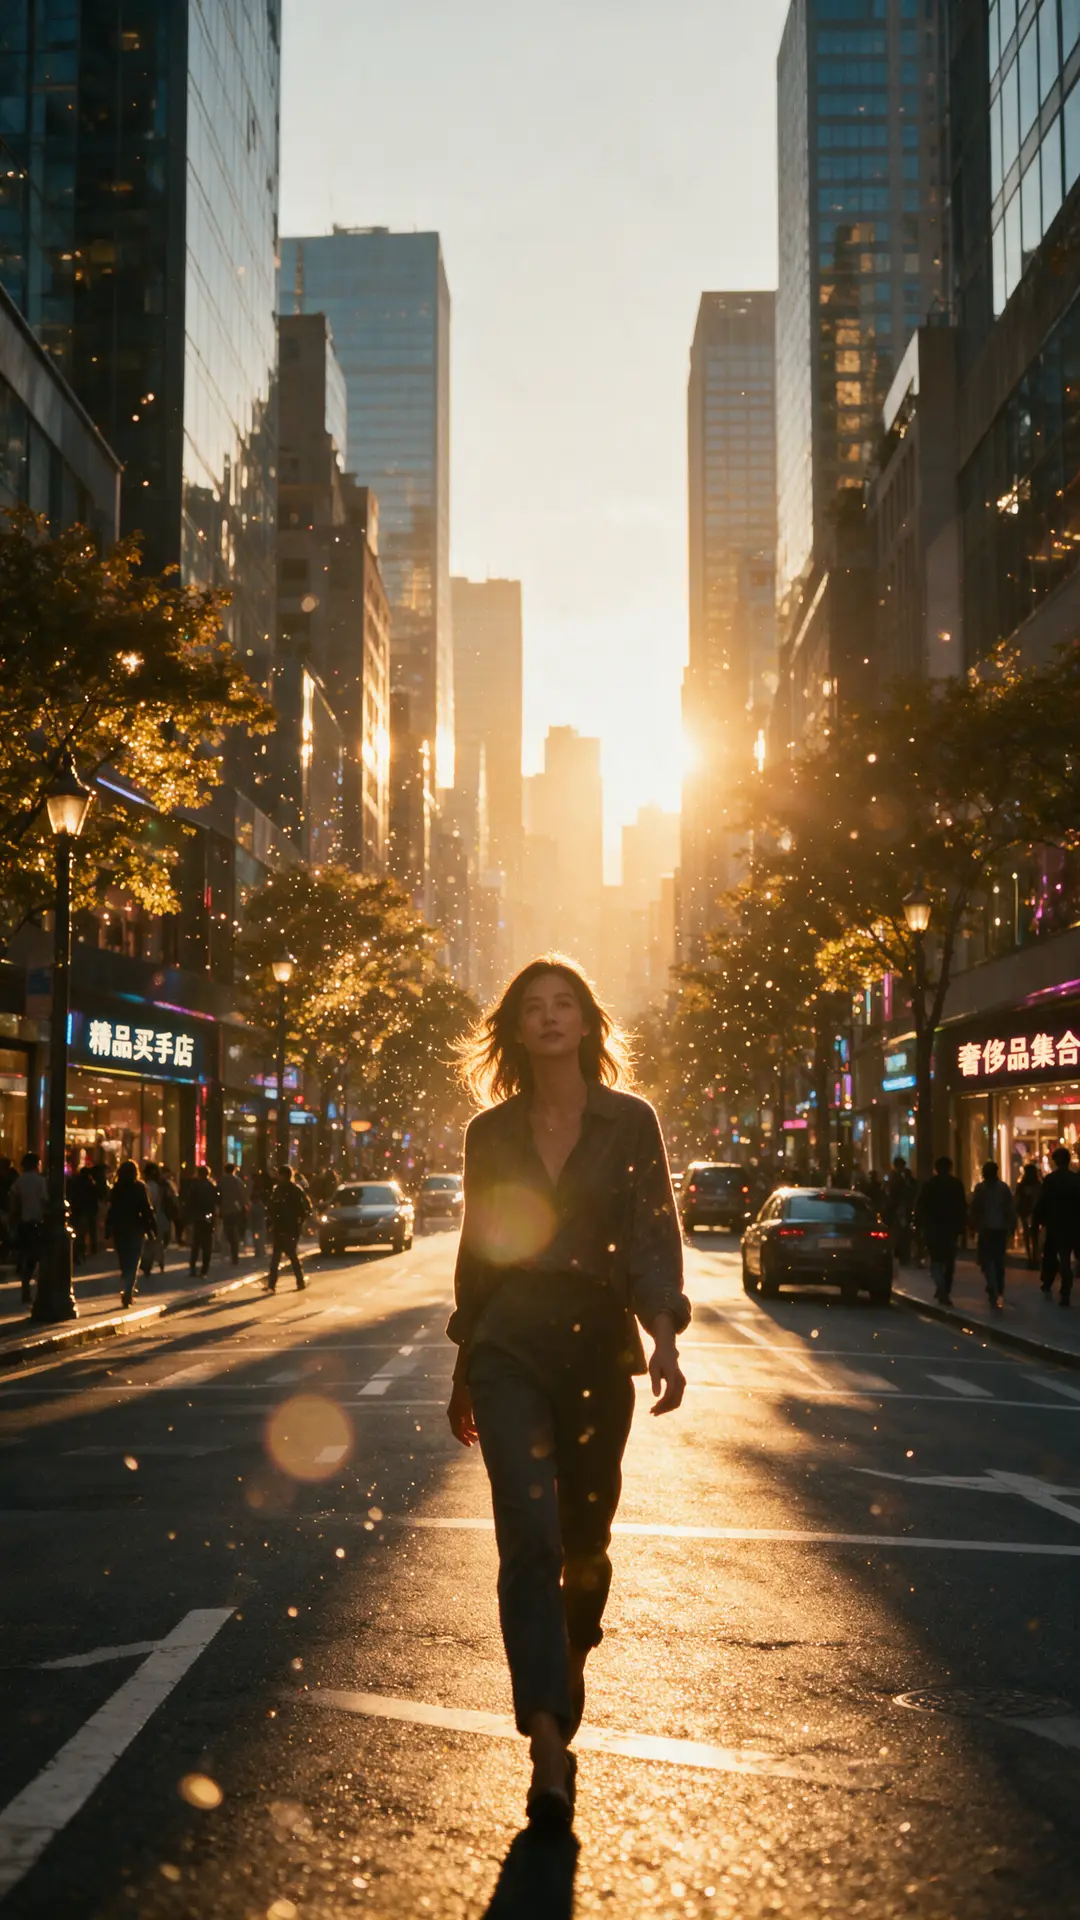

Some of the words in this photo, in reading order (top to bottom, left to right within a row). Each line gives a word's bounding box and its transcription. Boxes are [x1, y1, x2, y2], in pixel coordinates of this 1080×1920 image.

[89, 1019, 194, 1067] 精品买手店
[958, 1030, 1080, 1077] 奢侈品集合
